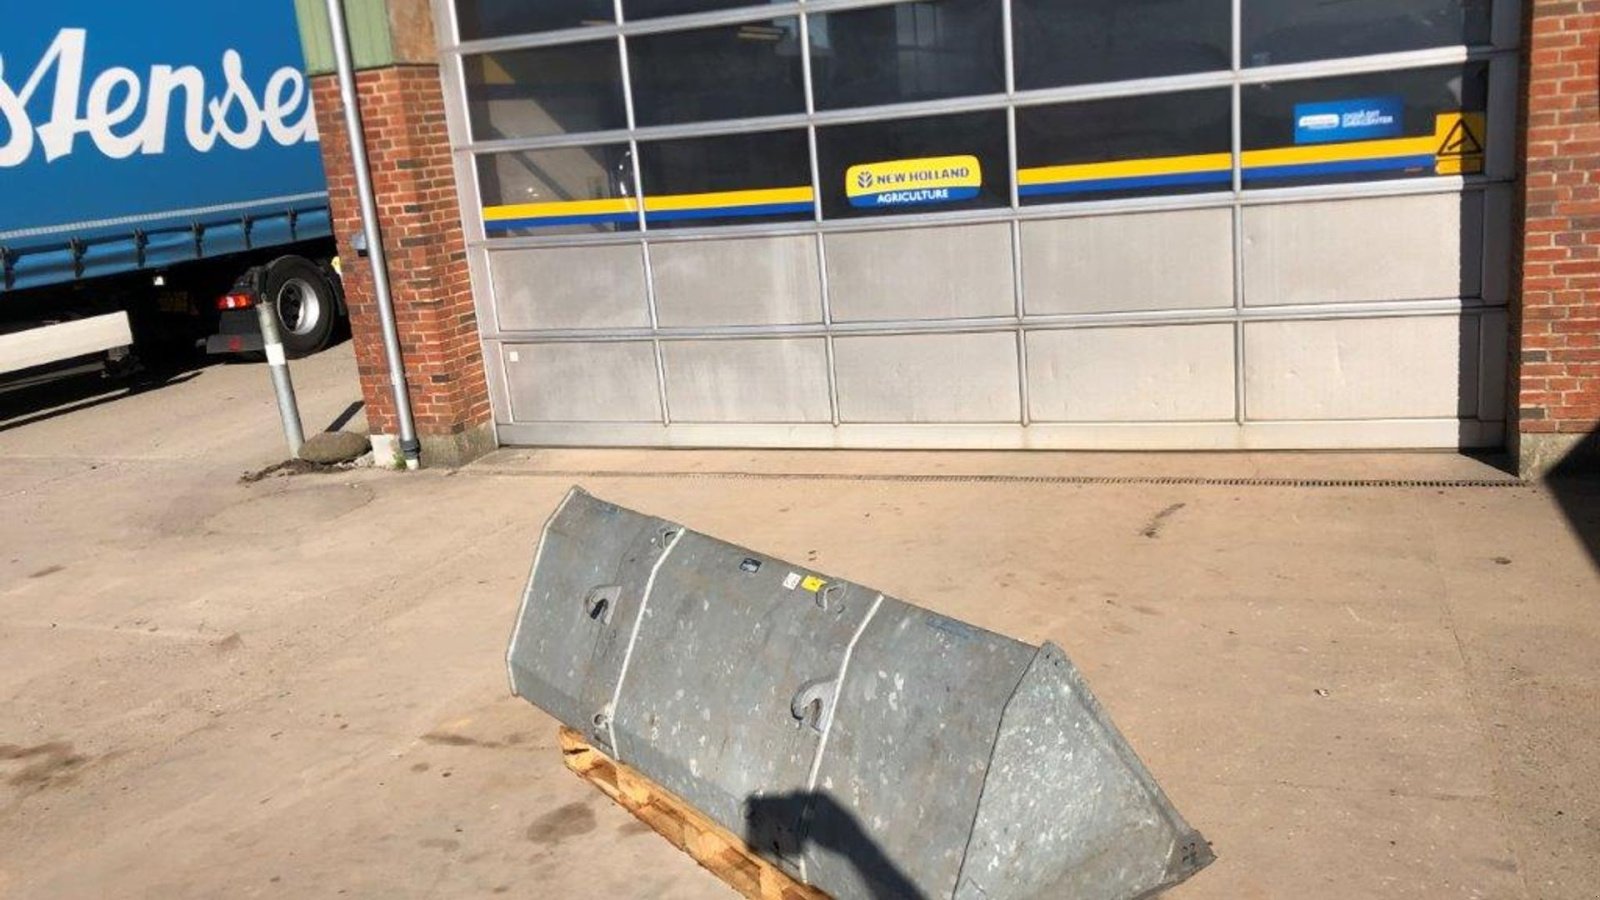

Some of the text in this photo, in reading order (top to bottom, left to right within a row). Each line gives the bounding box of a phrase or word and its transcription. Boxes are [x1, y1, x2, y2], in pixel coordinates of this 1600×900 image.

[877, 167, 969, 184] NEW HOLLAND
[877, 189, 948, 203] AGRICULTURE
